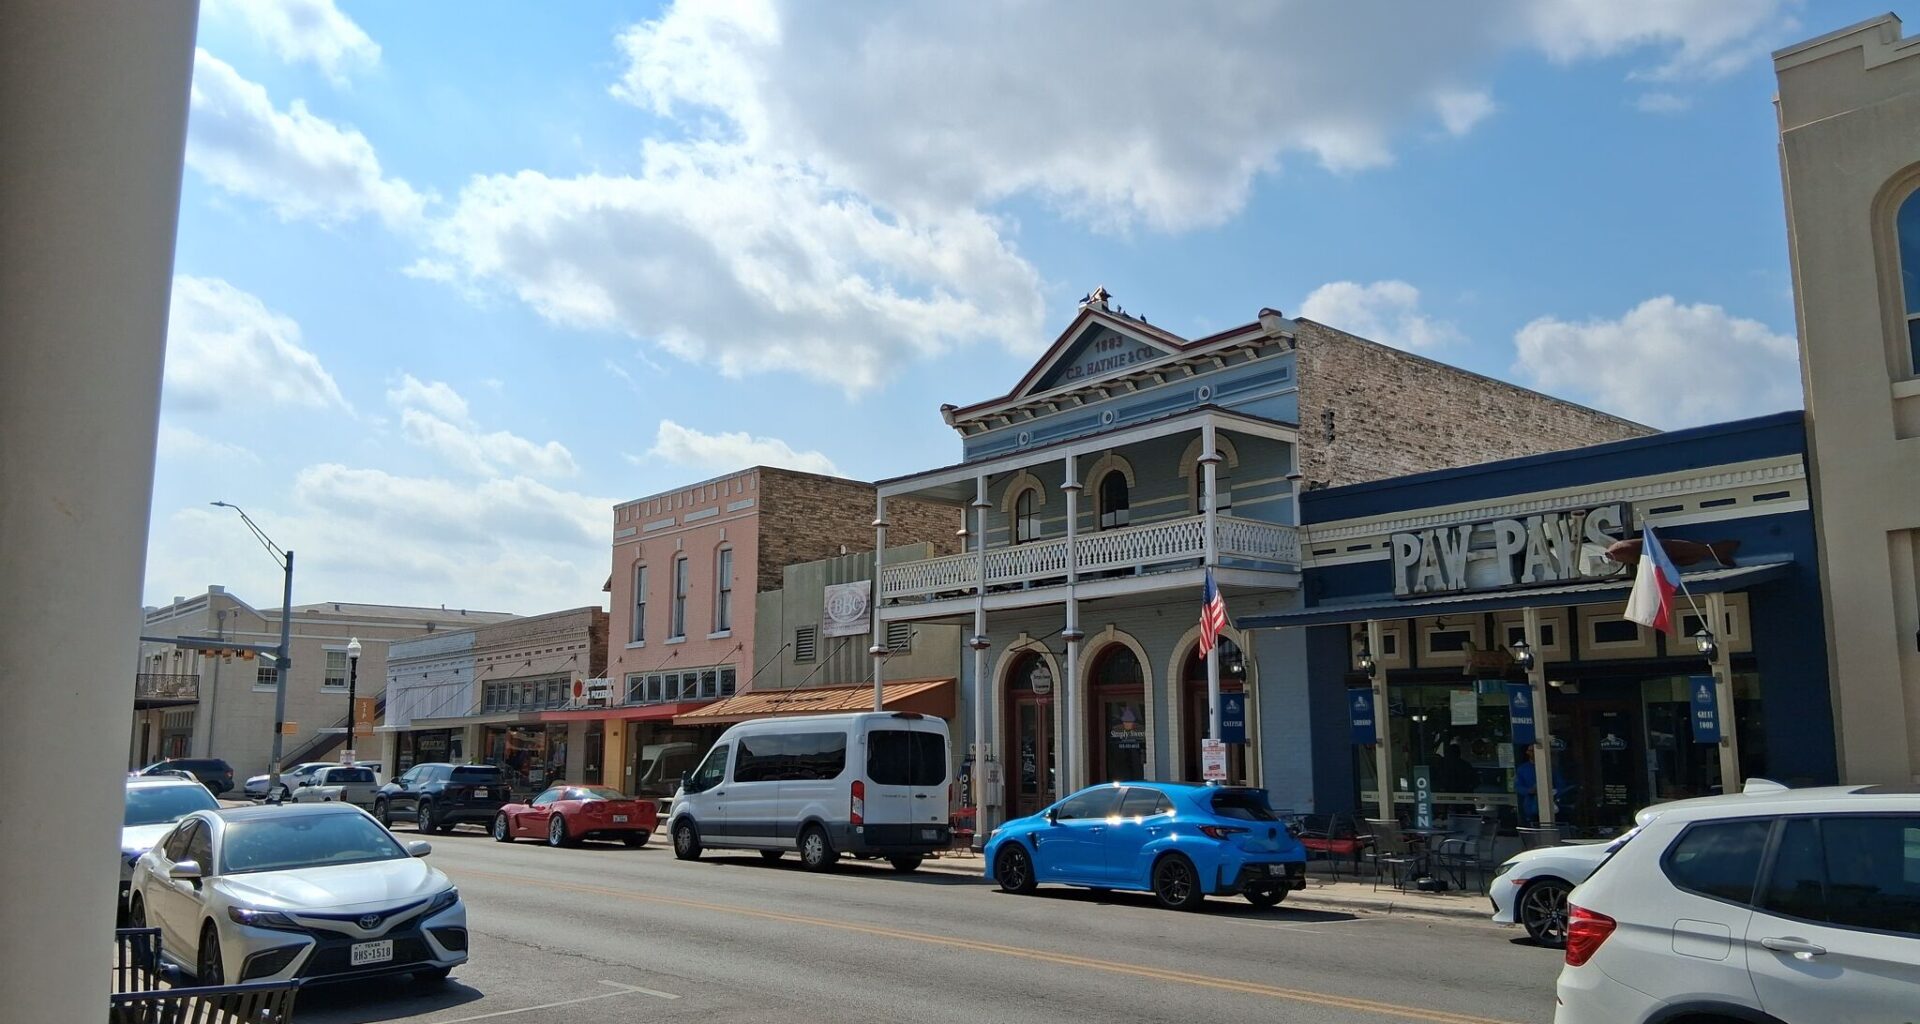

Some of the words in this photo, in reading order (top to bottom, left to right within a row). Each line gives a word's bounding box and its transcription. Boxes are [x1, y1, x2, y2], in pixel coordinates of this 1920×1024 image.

[1087, 354, 1126, 375] HAYNIE
[1128, 351, 1135, 363] &
[1095, 336, 1123, 353] 1883
[1391, 524, 1473, 595] PAW
[1417, 777, 1429, 827] OPEN
